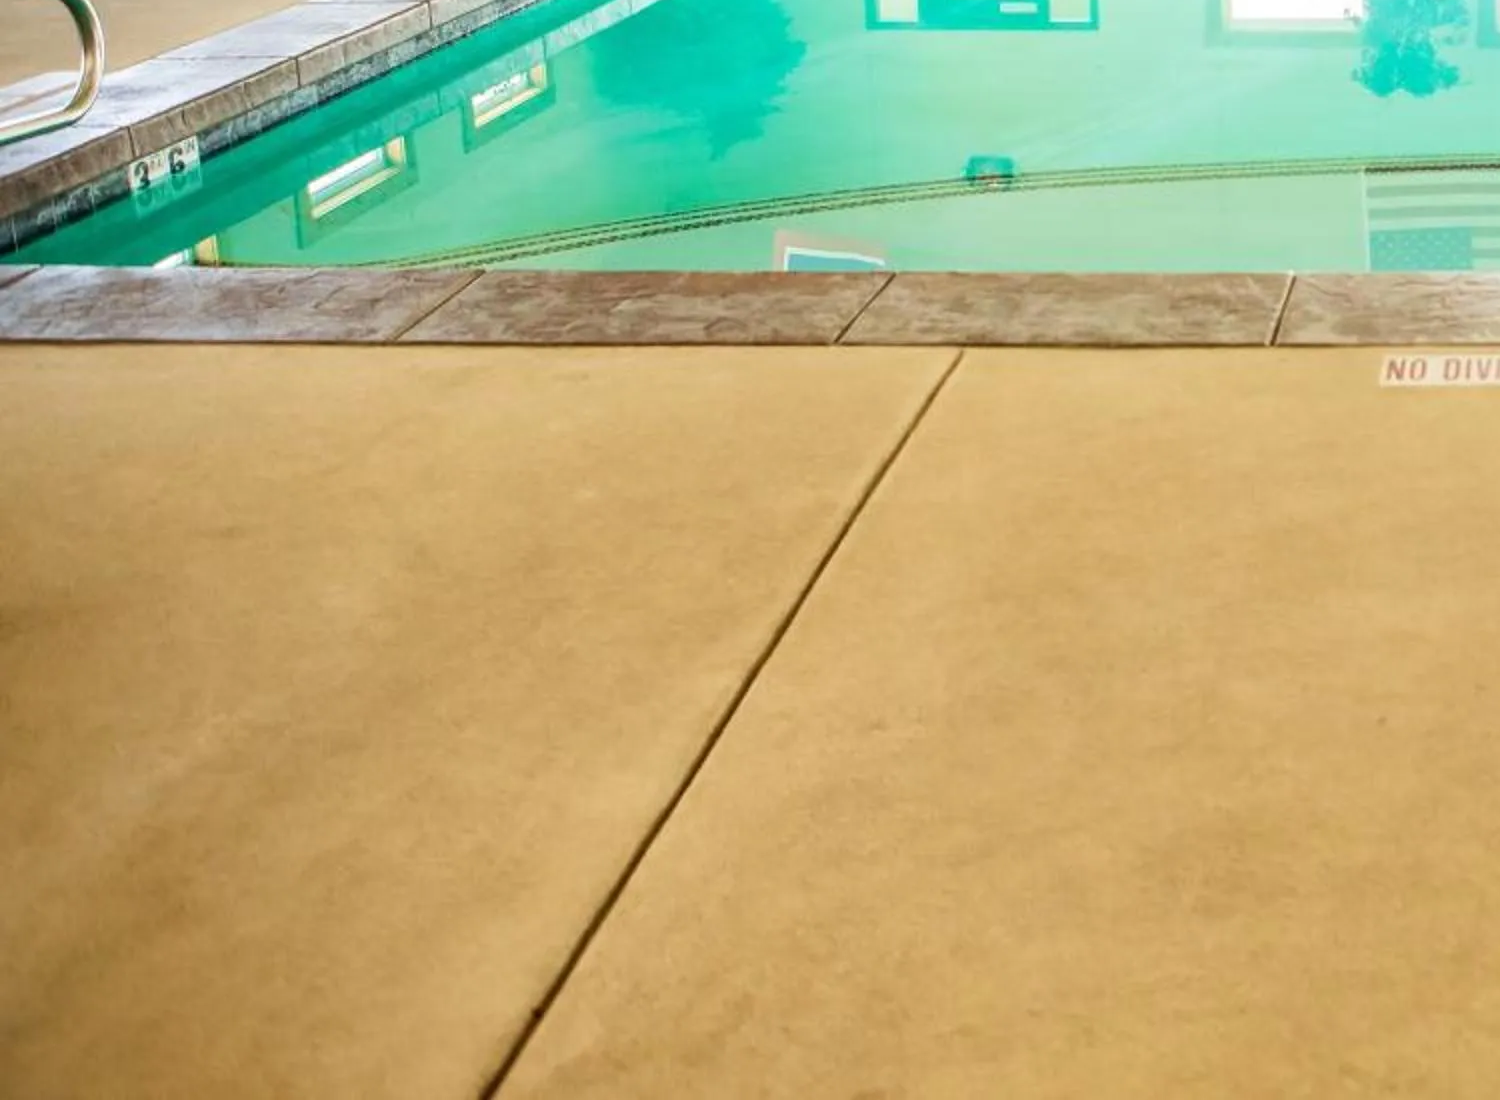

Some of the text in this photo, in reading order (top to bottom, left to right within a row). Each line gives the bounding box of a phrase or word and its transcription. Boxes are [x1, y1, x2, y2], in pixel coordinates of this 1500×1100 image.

[134, 161, 151, 190] 3
[167, 146, 186, 174] 6
[1385, 359, 1428, 382] NO
